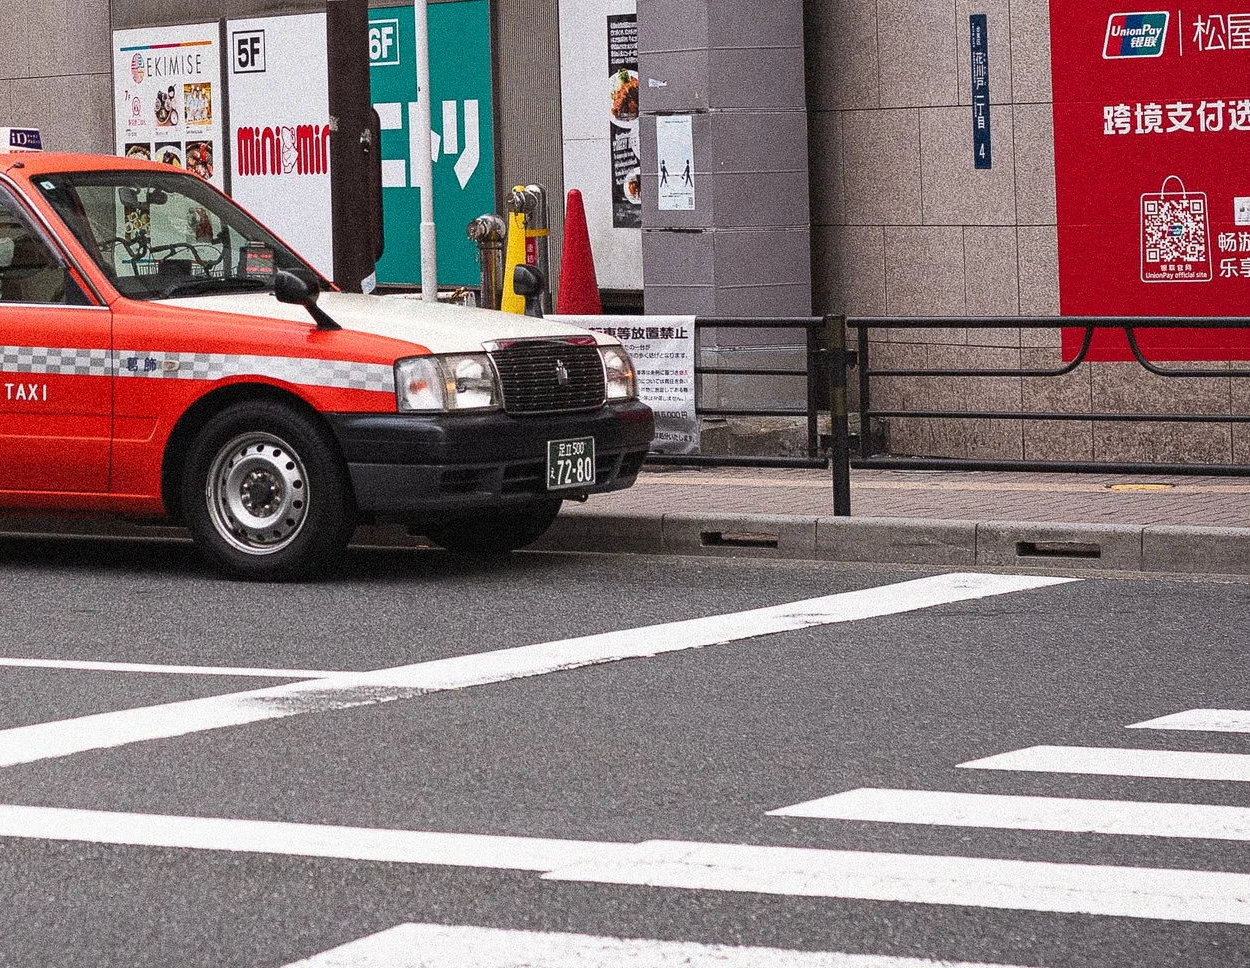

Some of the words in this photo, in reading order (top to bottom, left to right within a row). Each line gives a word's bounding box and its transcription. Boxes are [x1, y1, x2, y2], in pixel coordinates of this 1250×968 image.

[1111, 23, 1163, 40] UnionPay
[1192, 13, 1250, 51] 松屋
[369, 26, 394, 60] 6F
[1130, 36, 1158, 48] 银联
[237, 36, 261, 68] 5F
[146, 54, 202, 77] EKIMISE
[11, 132, 27, 145] iD
[979, 143, 985, 159] 4
[4, 382, 47, 401] TAXI
[559, 443, 572, 456] 足立
[572, 442, 585, 455] 500
[557, 457, 592, 485] 72-80
